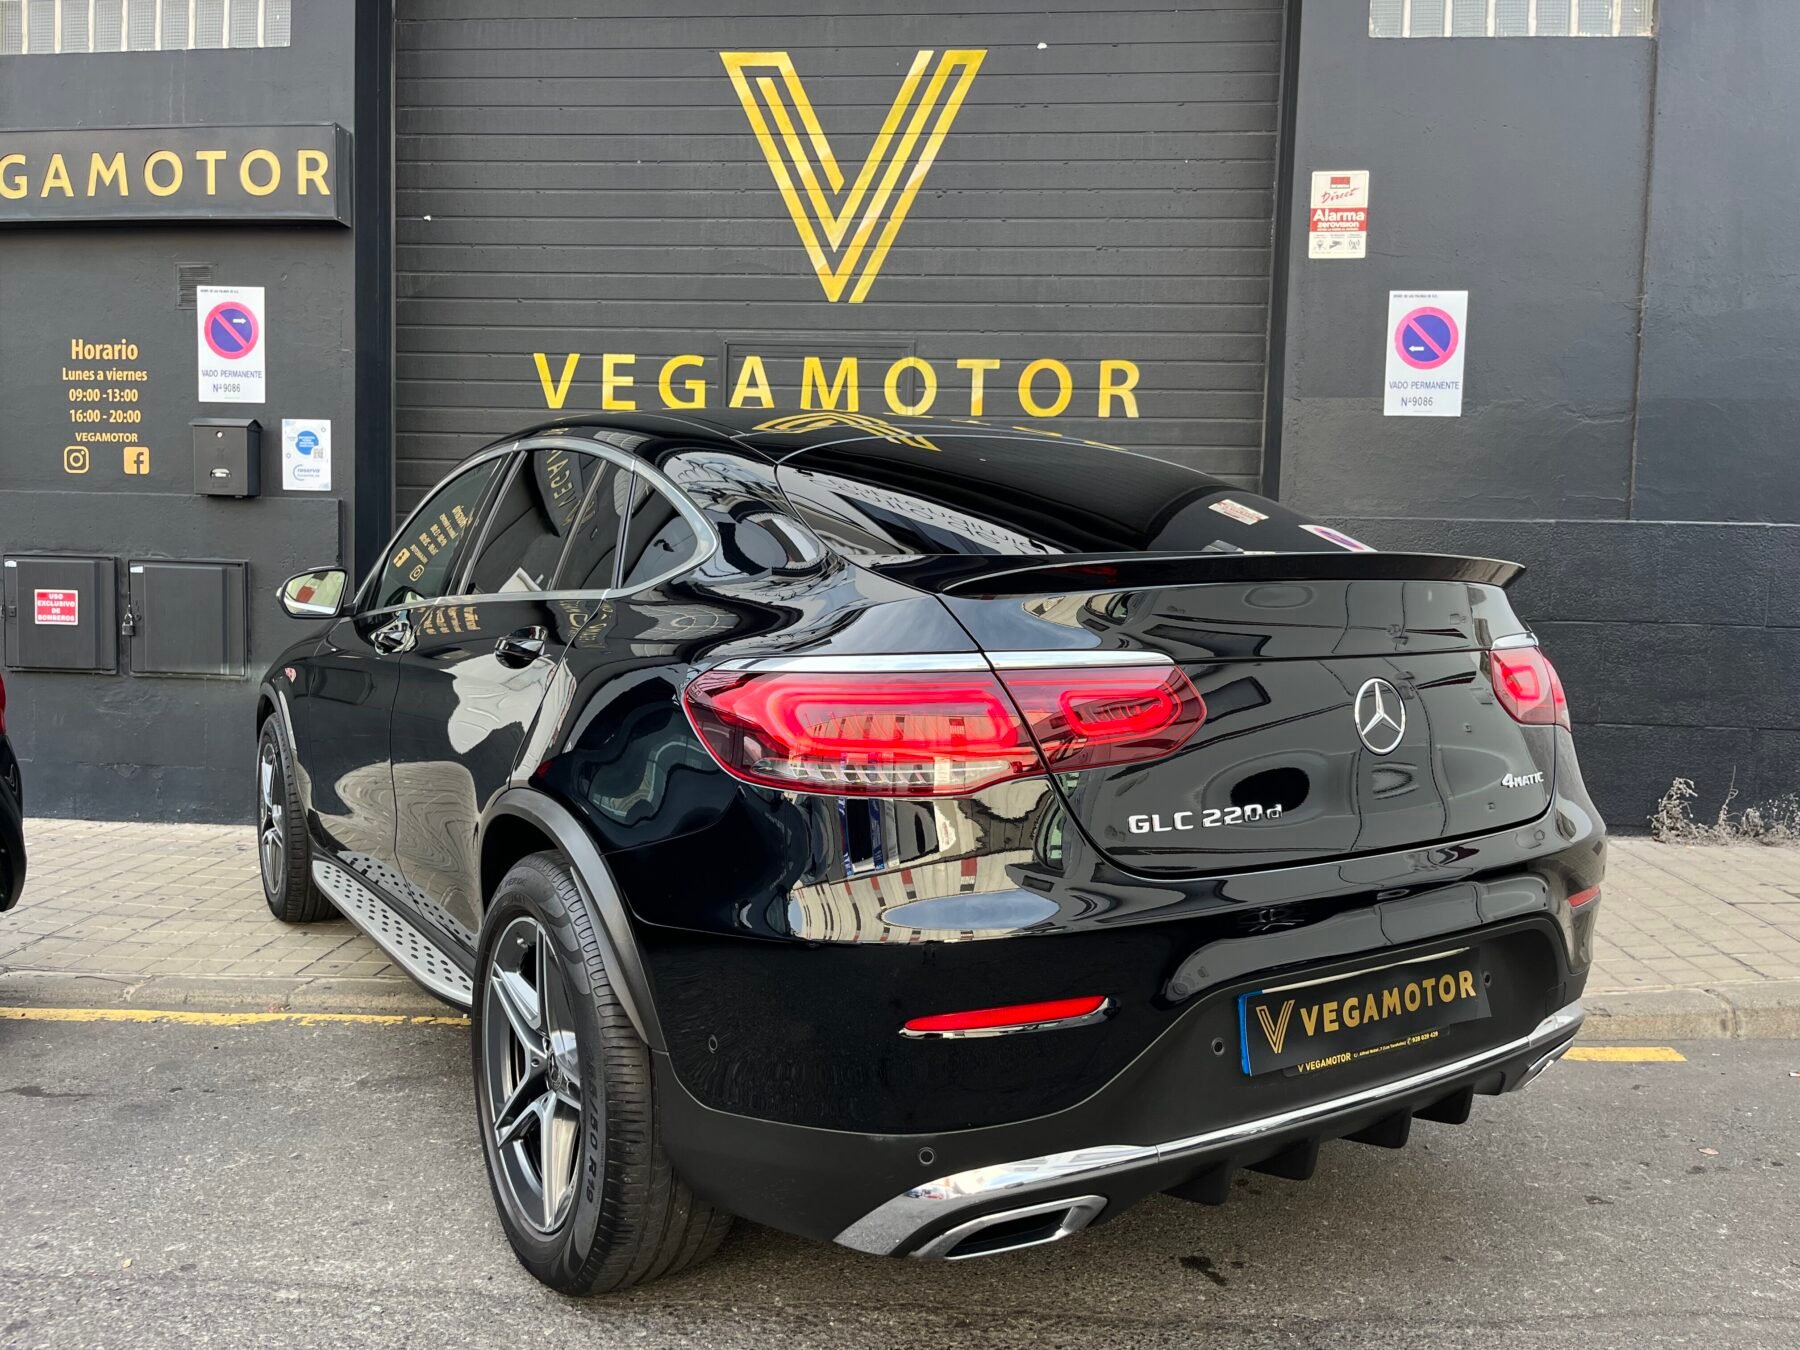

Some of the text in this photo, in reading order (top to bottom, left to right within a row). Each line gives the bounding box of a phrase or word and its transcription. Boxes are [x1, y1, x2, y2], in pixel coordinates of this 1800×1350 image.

[0, 149, 331, 199] GAMOTOR
[1312, 208, 1365, 222] Alarma
[71, 338, 139, 360] Horario
[62, 367, 148, 381] Lunes a viernes
[201, 369, 262, 379] VADO PERMANENTE
[533, 352, 1139, 419] VEGAMOTOR
[1388, 380, 1461, 391] VADO PERMANENTE
[69, 388, 100, 402] 09:00
[69, 409, 100, 422] 16:00
[109, 410, 141, 423] 20:00
[75, 432, 138, 443] VEGAMOTOR
[1501, 771, 1544, 788] 4MATIC
[1128, 811, 1194, 834] GLC
[1300, 970, 1477, 1037] VEGAMOTOR
[1305, 1052, 1351, 1071] VEGAMOTOR
